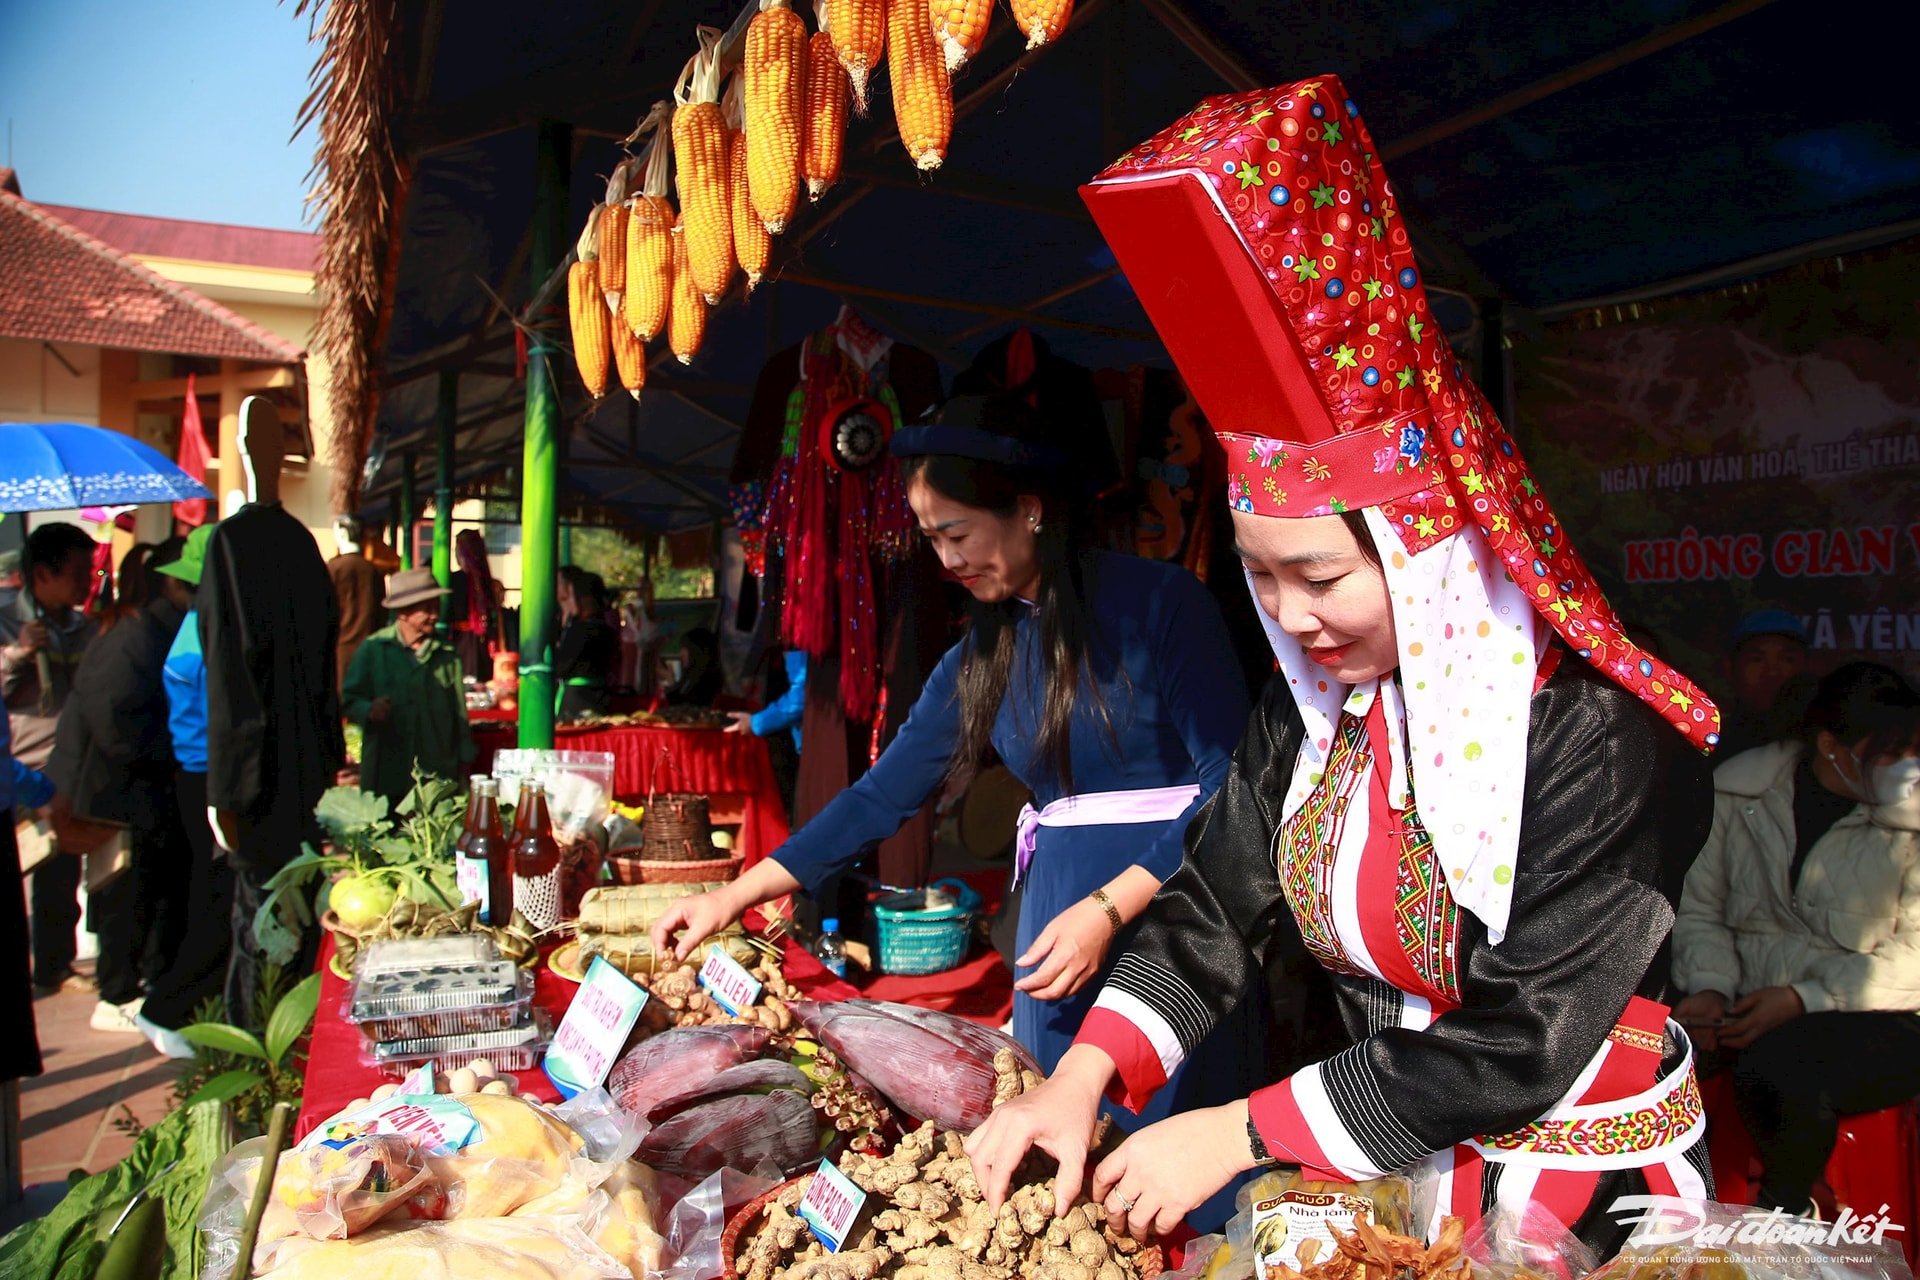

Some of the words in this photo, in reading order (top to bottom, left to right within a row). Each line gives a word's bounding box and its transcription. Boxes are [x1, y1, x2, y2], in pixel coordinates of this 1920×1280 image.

[1600, 463, 1649, 493] NGÀY
[1656, 460, 1693, 493] HỘI
[1699, 453, 1744, 484] VĂN
[1624, 525, 1764, 583] KHÔNG
[1772, 524, 1897, 577] GIAN
[705, 958, 726, 987] ĐỊA
[1261, 1195, 1286, 1210] DƯA
[1289, 1206, 1319, 1217] Nhà
